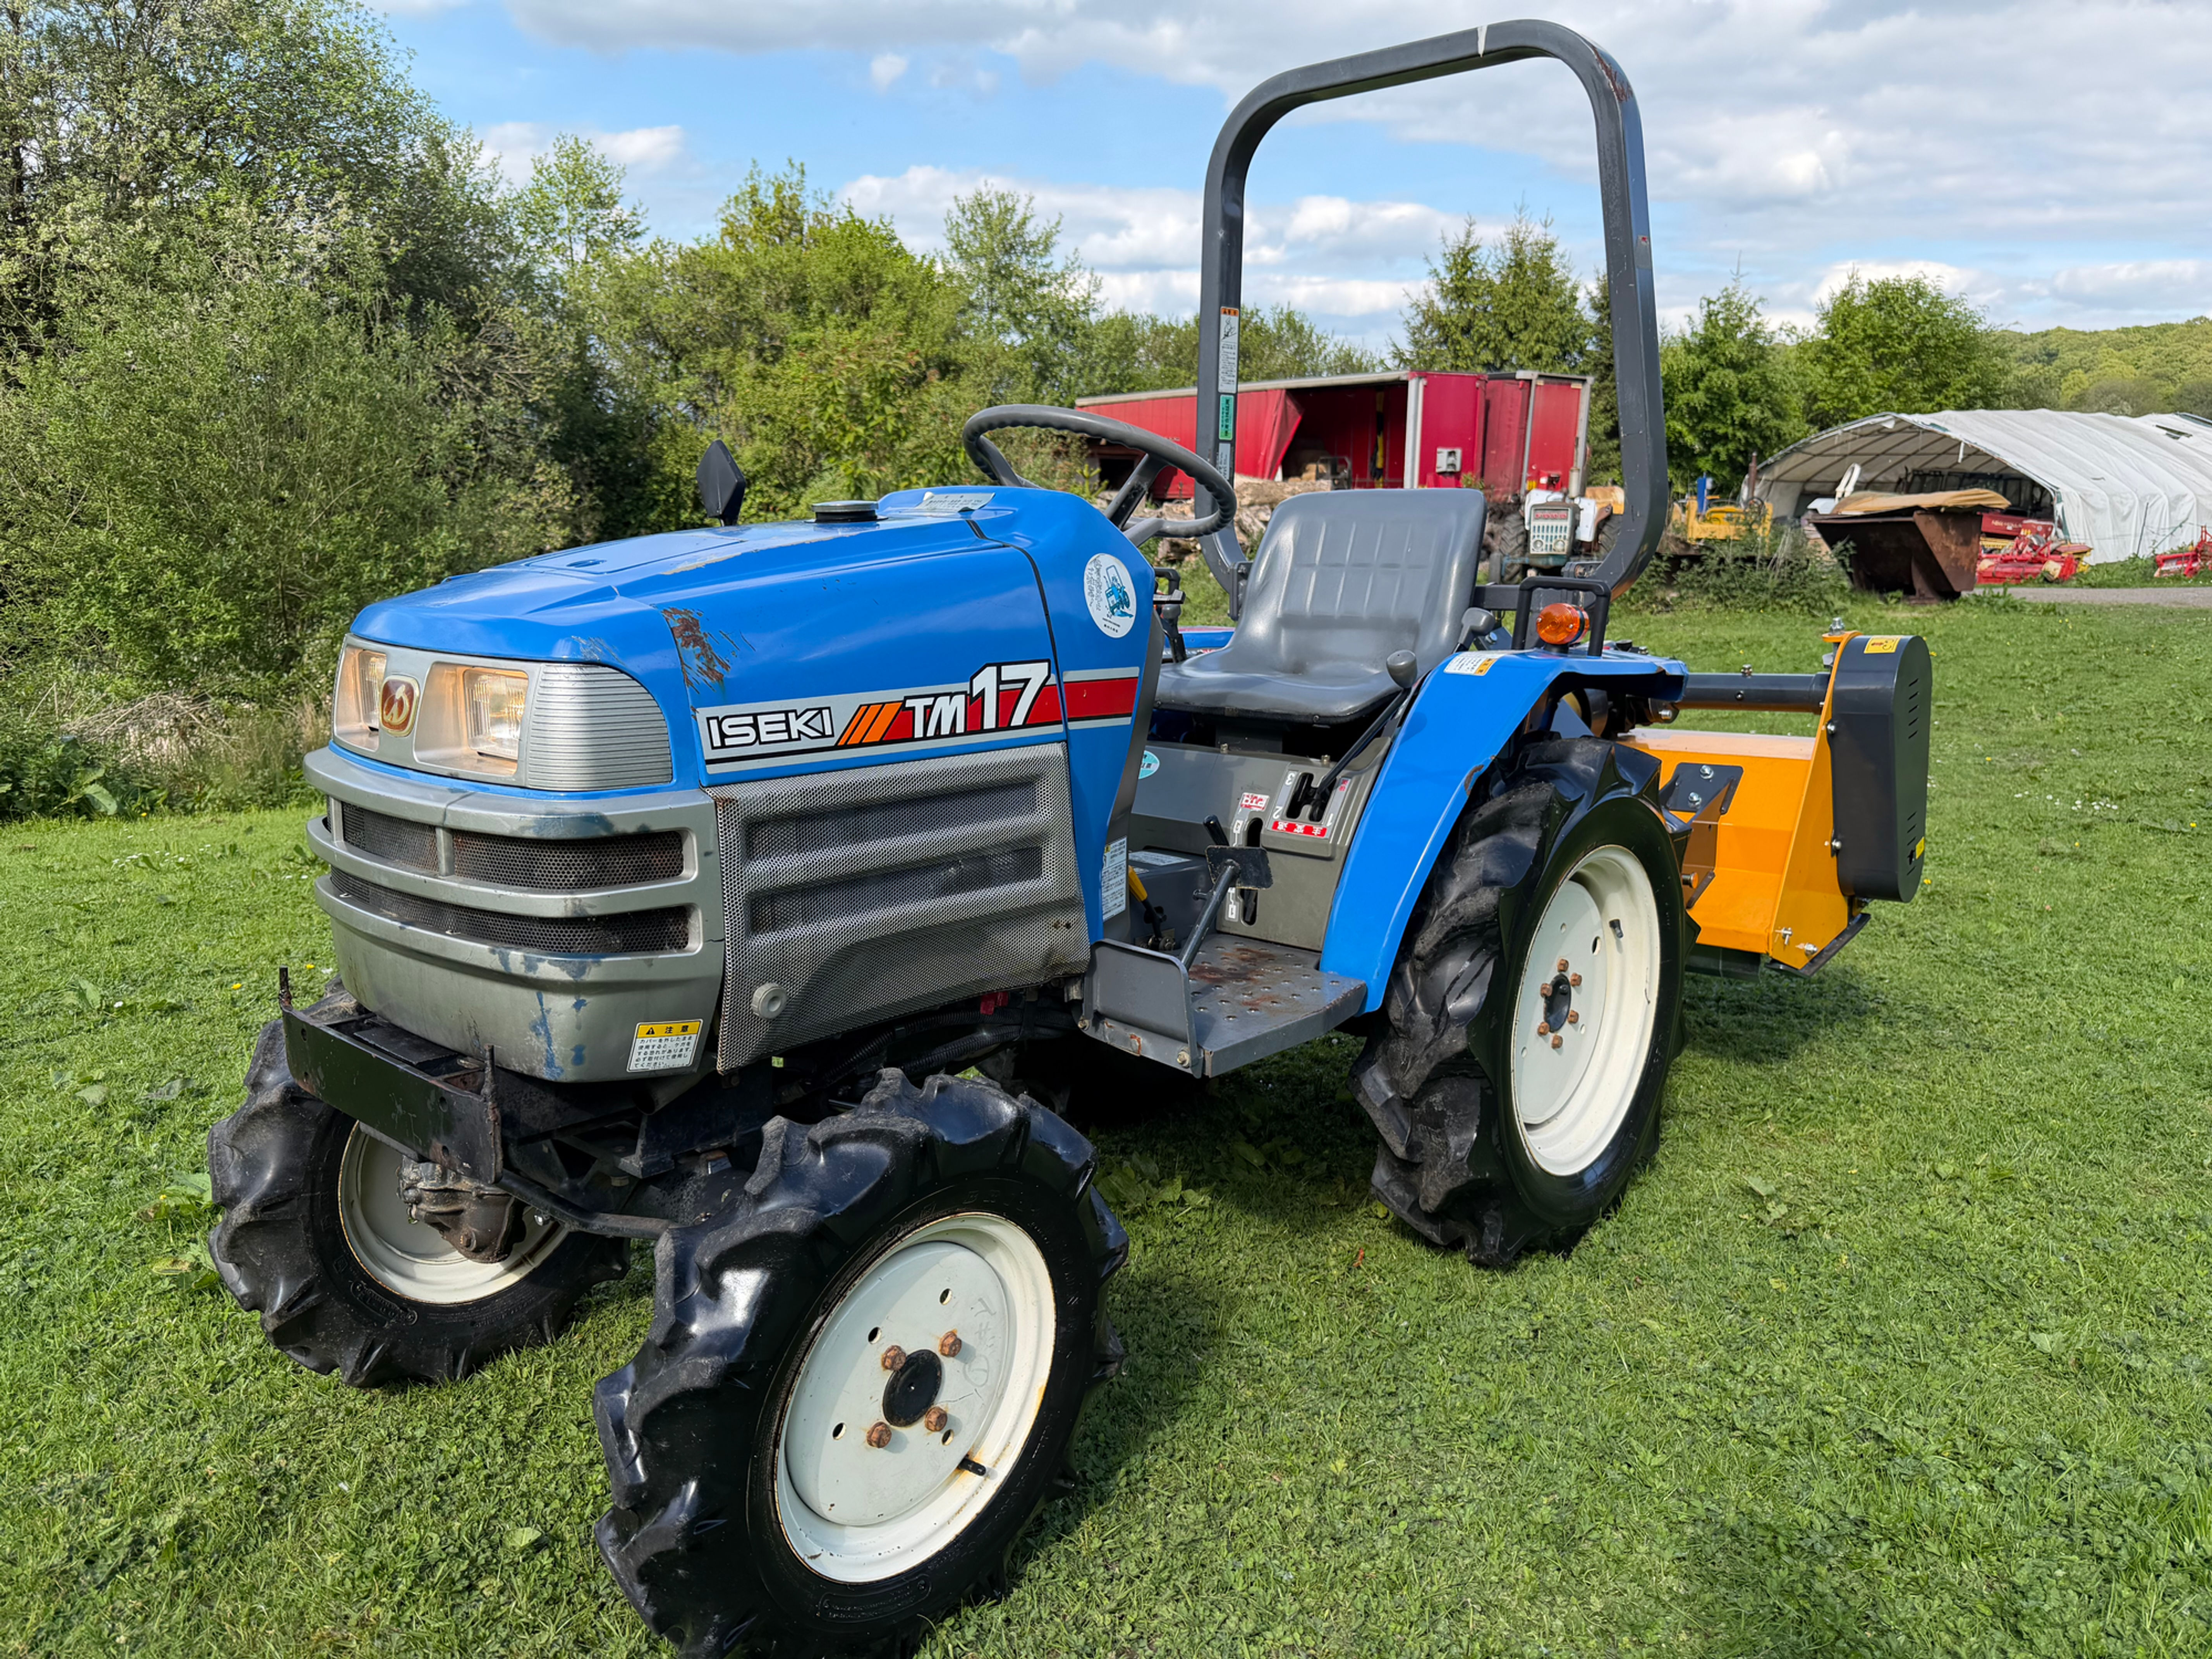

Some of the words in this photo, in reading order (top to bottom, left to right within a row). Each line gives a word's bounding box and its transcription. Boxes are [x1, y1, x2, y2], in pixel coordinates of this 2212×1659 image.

[903, 659, 1051, 739] TM17
[706, 706, 834, 749] ISEKI
[1285, 773, 1295, 785] 3
[1273, 806, 1283, 819] 2
[1327, 813, 1333, 826] 1
